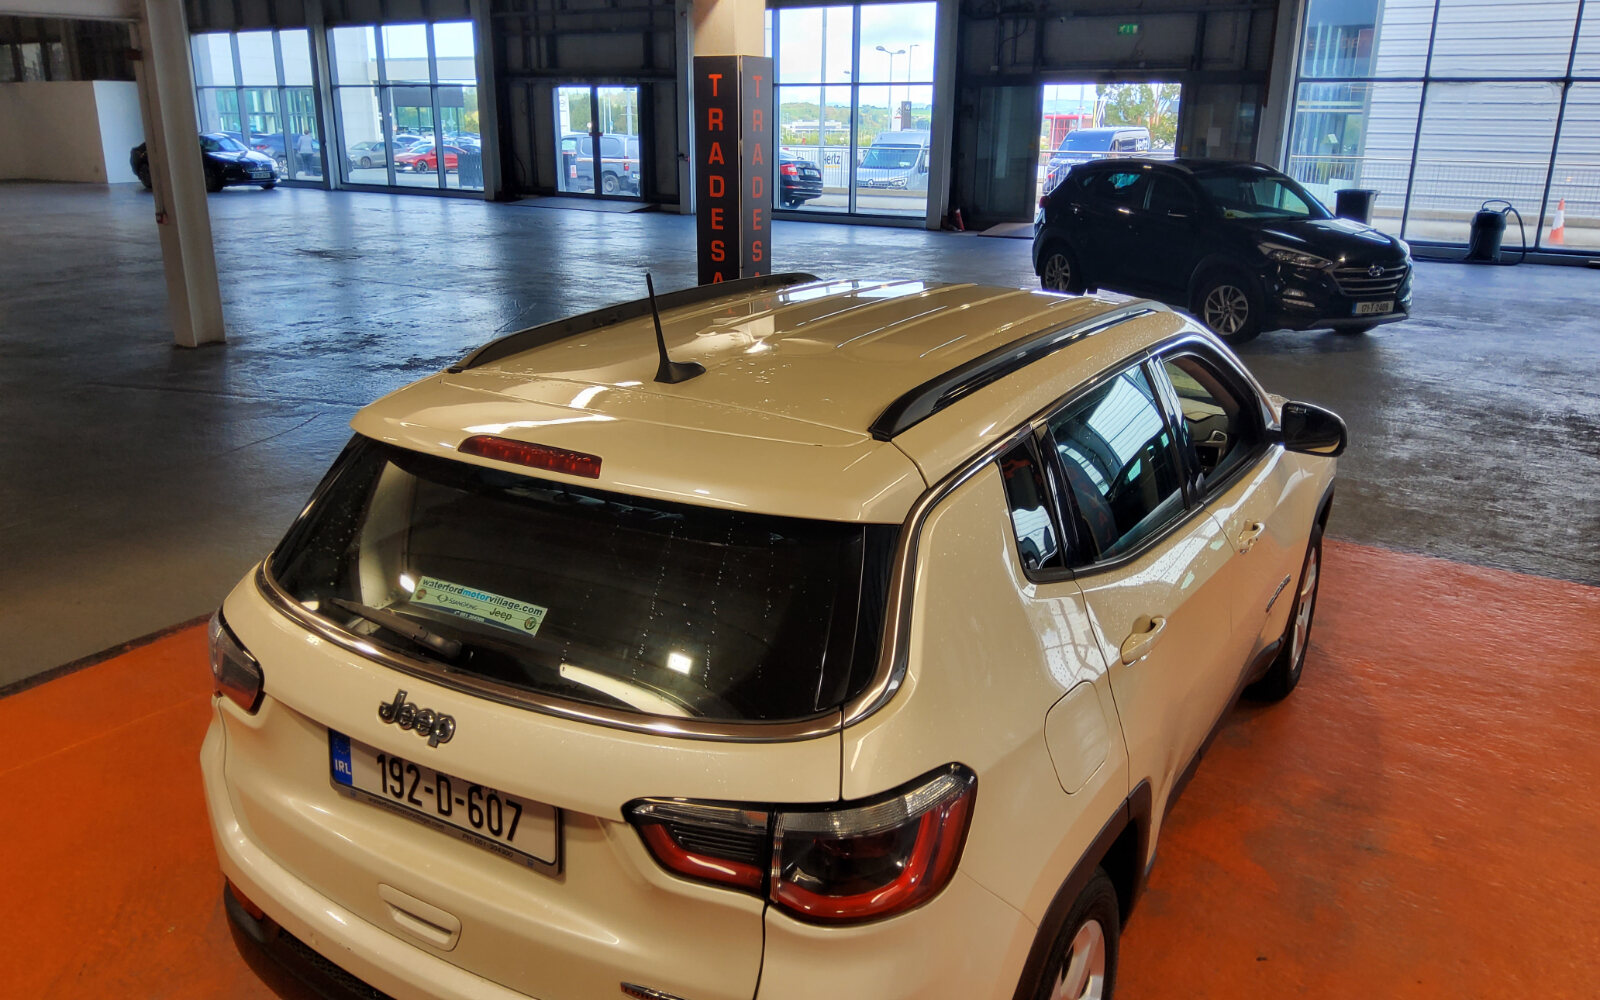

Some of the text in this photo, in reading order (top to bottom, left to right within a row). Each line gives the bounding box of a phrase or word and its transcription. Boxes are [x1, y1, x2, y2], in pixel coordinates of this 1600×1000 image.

[422, 578, 544, 616] waterfordmotorvillage.com
[489, 607, 513, 621] Jeep
[378, 689, 456, 748] Jeep
[334, 758, 352, 775] IRL
[376, 753, 523, 842] 192-D-607
